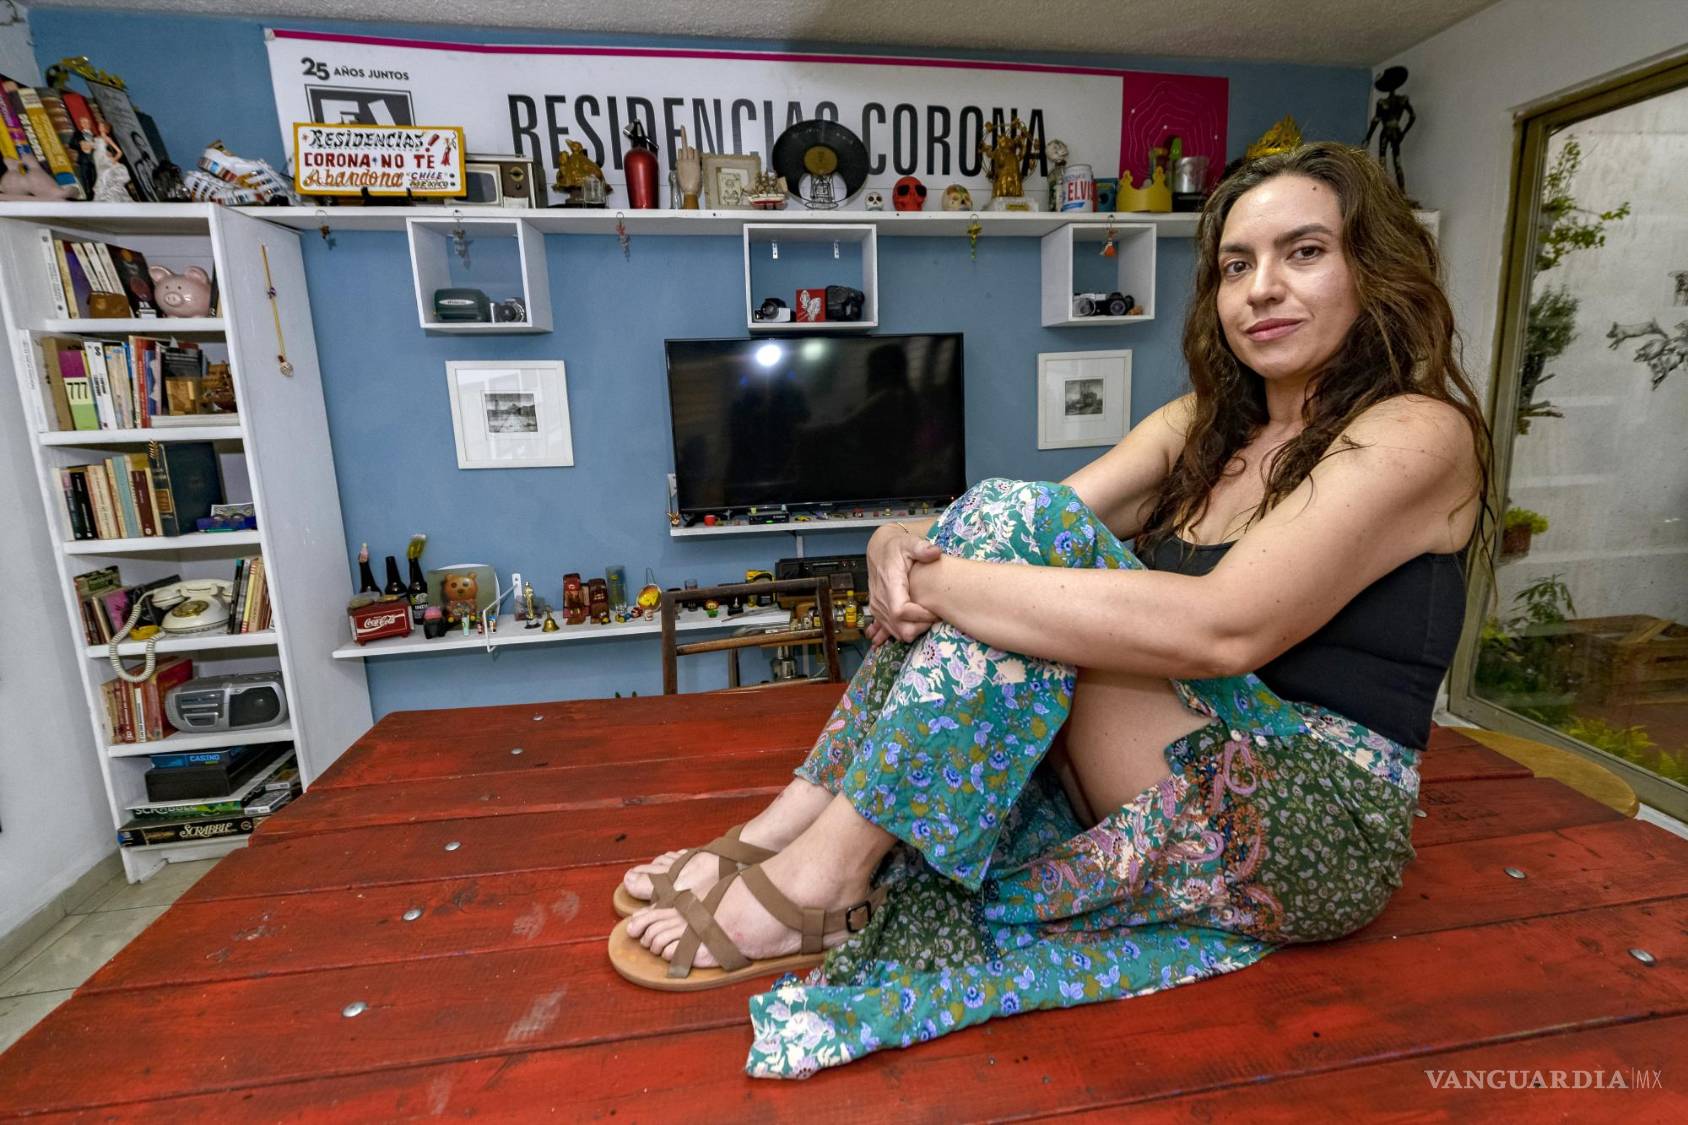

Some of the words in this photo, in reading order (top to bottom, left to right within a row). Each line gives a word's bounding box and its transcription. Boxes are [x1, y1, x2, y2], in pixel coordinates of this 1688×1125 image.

[301, 57, 330, 80] 25
[334, 65, 365, 78] AÑOS
[368, 69, 409, 81] JUNTOS
[507, 94, 839, 175] RESIDENCI
[304, 152, 371, 168] CORONA
[381, 154, 404, 168] NO
[414, 155, 435, 168] TE
[66, 381, 88, 400] 777
